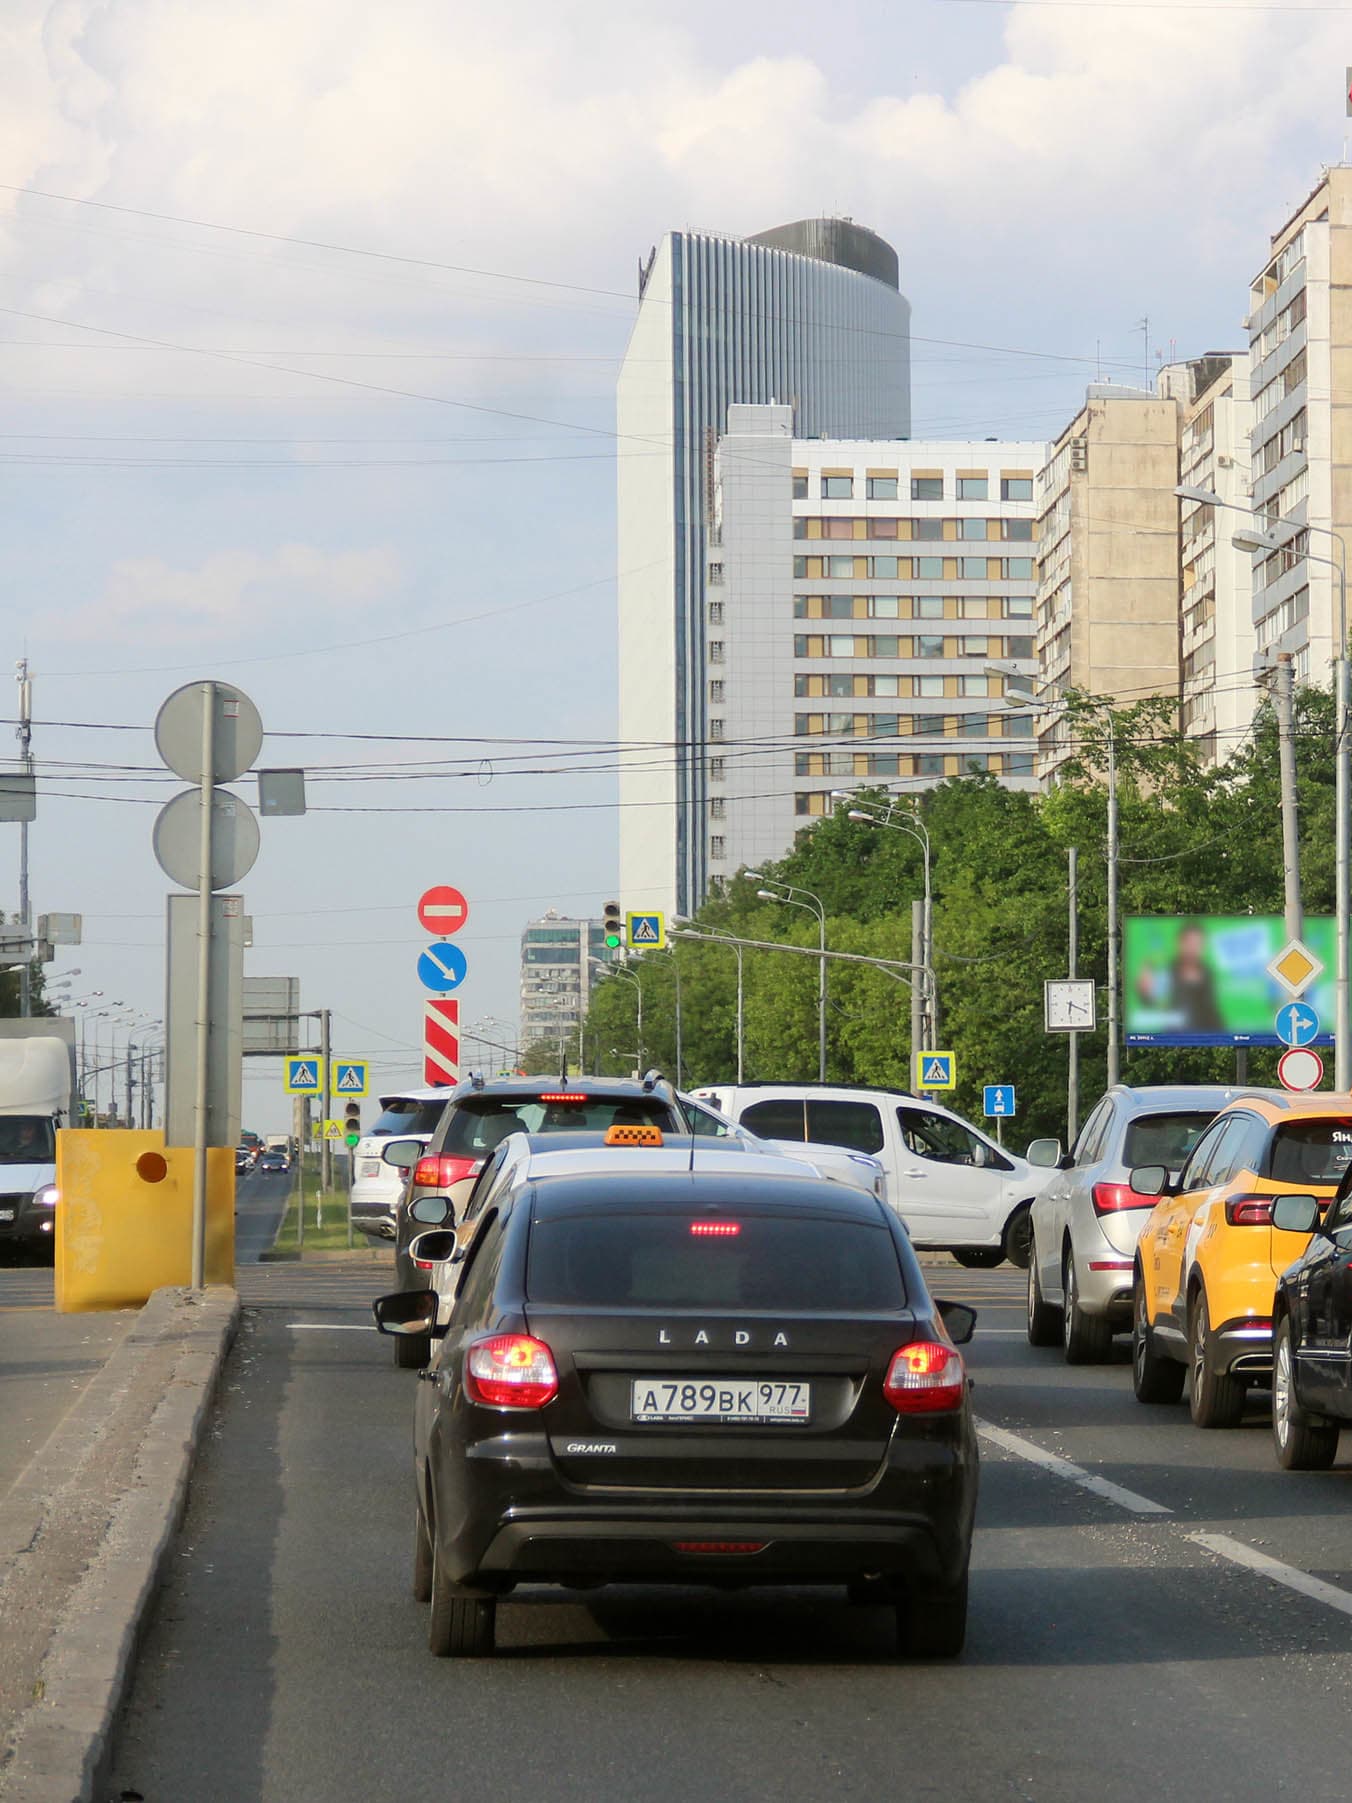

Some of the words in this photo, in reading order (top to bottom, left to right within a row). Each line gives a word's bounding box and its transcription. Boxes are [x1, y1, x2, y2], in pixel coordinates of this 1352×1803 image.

[659, 1330, 788, 1346] LADA
[643, 1384, 753, 1412] А789ВК
[759, 1384, 801, 1405] 977
[769, 1406, 790, 1414] RUS
[567, 1443, 617, 1453] GRANTA
